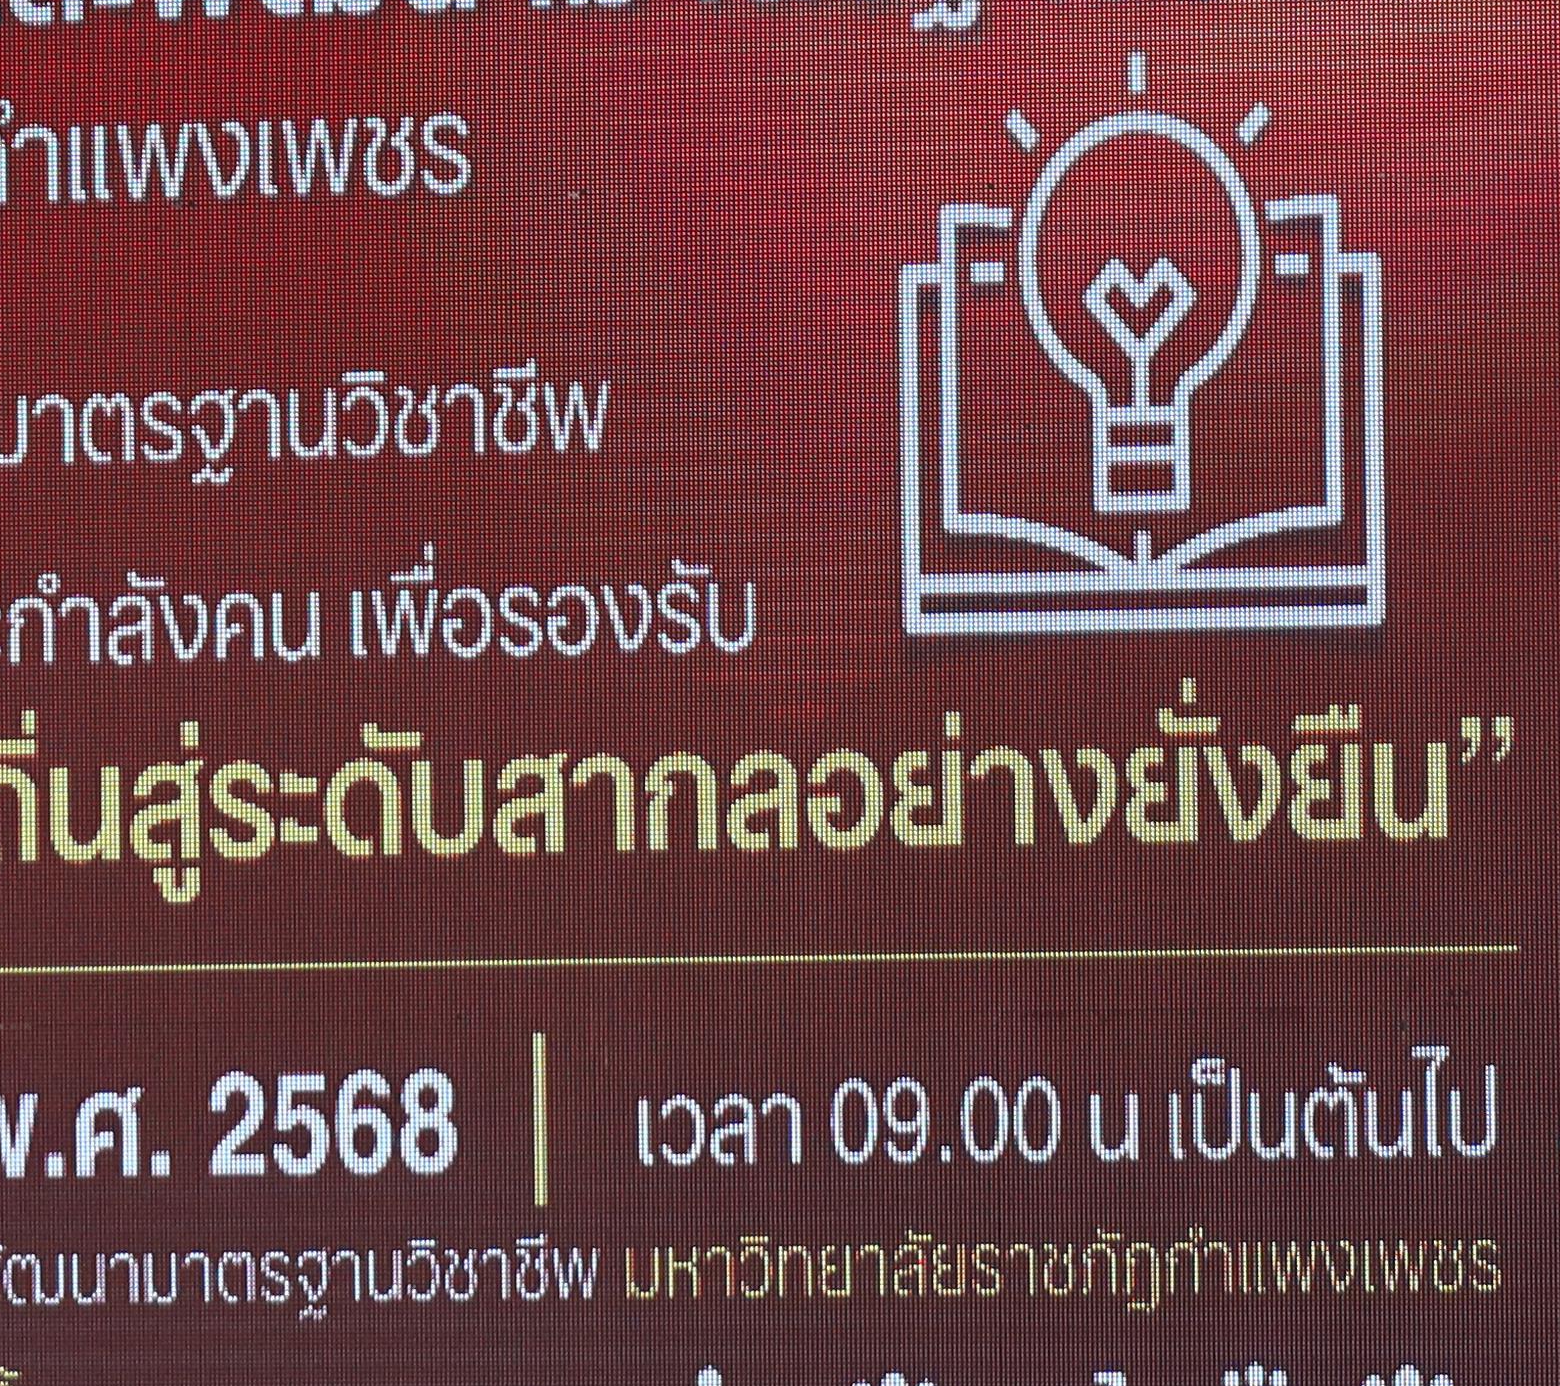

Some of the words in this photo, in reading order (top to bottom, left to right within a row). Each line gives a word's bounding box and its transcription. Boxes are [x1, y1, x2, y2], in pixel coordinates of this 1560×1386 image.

[350, 542, 757, 660] เพื่อรองรับ
[209, 1068, 458, 1177] 2568
[637, 1091, 803, 1167] เวลา
[830, 1075, 1062, 1165] 09.00
[1089, 1092, 1140, 1163] น
[1168, 1045, 1498, 1162] เป็นต้นไป
[624, 1226, 1503, 1313] มหาวิทยาลัยราชภัฏกำแพงเพชร
